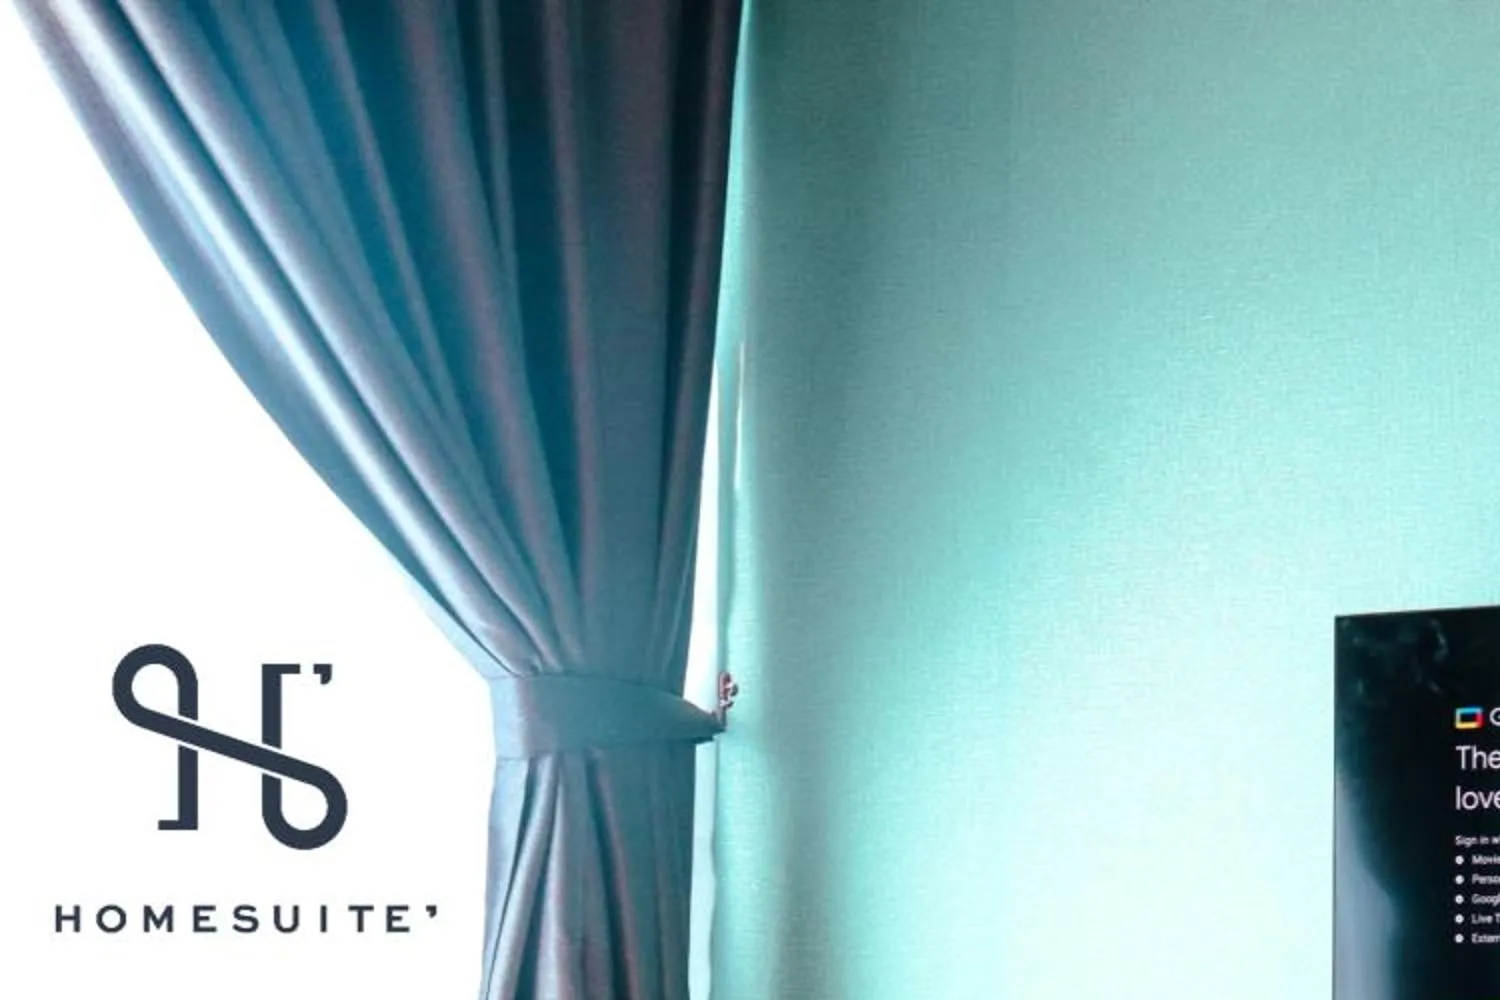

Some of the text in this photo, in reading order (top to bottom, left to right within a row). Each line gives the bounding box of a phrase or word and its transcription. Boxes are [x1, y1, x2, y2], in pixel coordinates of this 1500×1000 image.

[1455, 835, 1477, 847] Sign
[1480, 835, 1489, 844] in
[1471, 913, 1493, 924] Live
